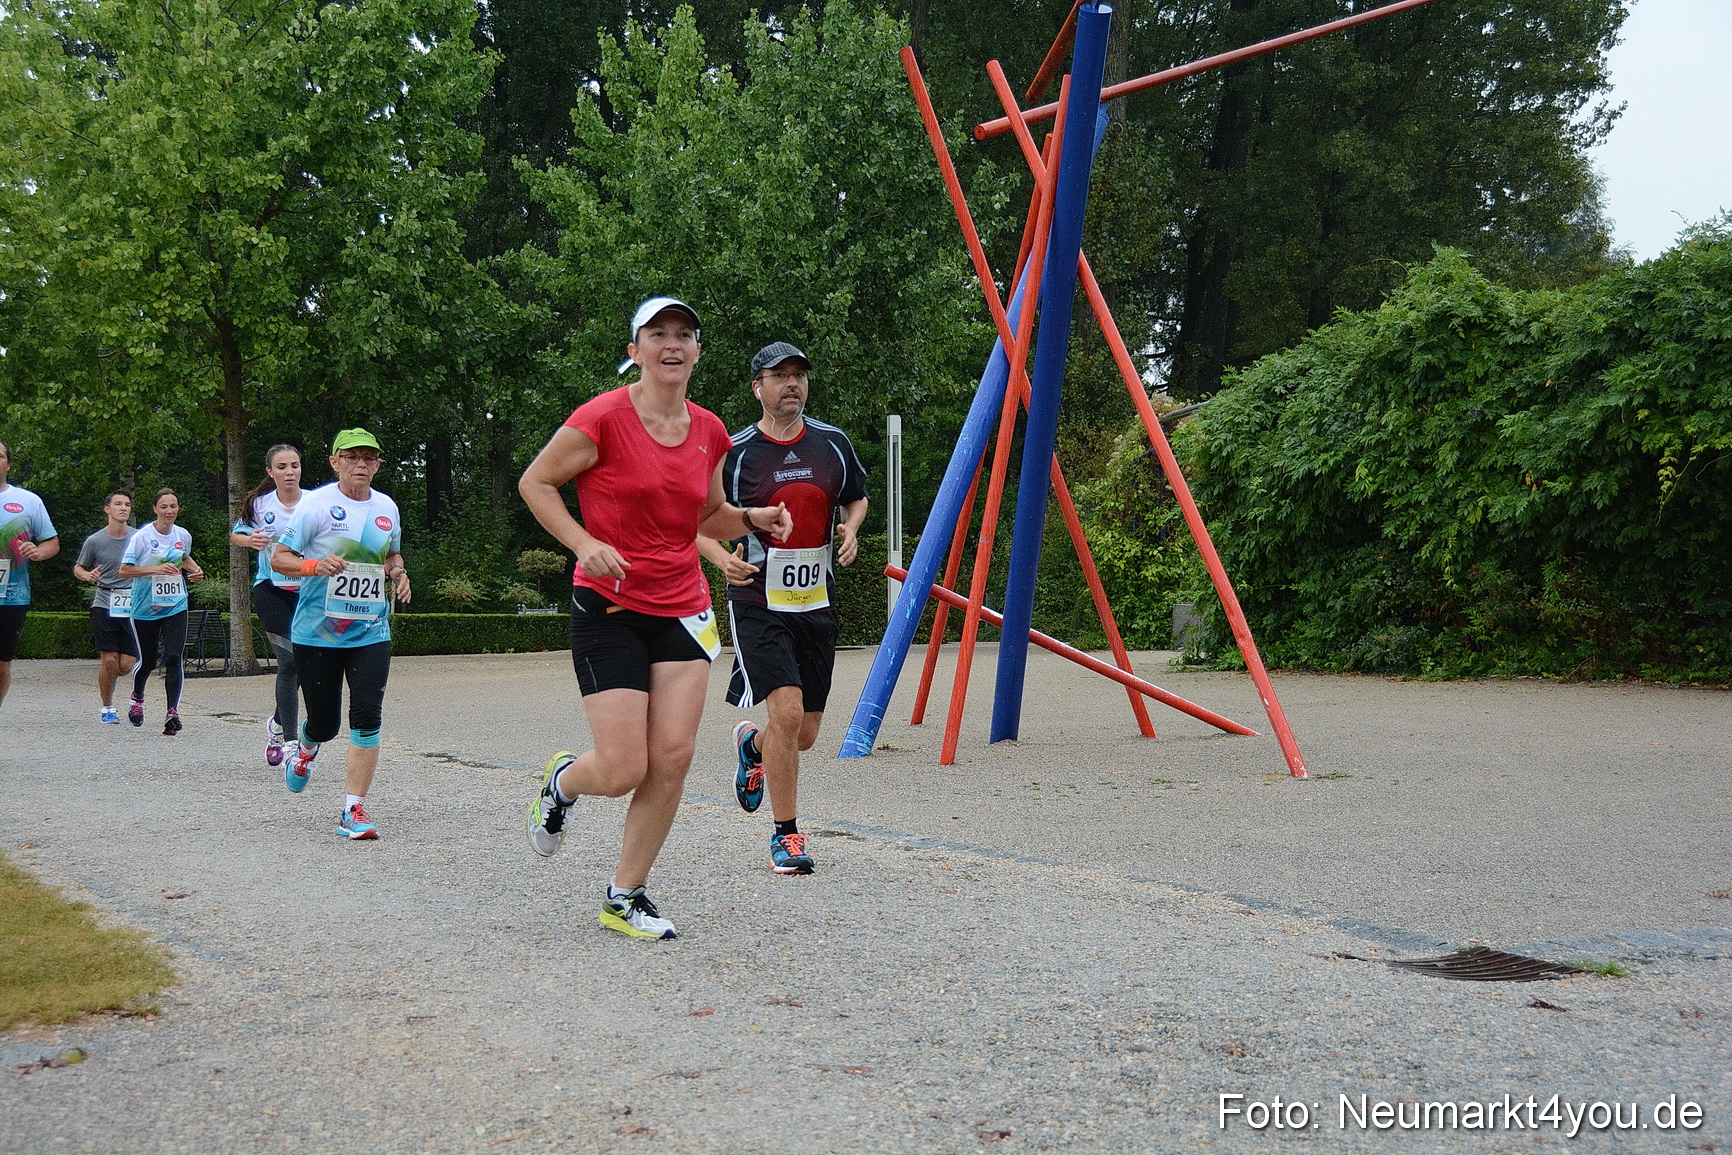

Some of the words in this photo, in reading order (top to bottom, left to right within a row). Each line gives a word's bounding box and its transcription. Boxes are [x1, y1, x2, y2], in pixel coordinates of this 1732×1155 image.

[782, 563, 820, 588] 609
[156, 582, 181, 595] 3061
[334, 575, 380, 599] 2024
[344, 602, 370, 613] Theres
